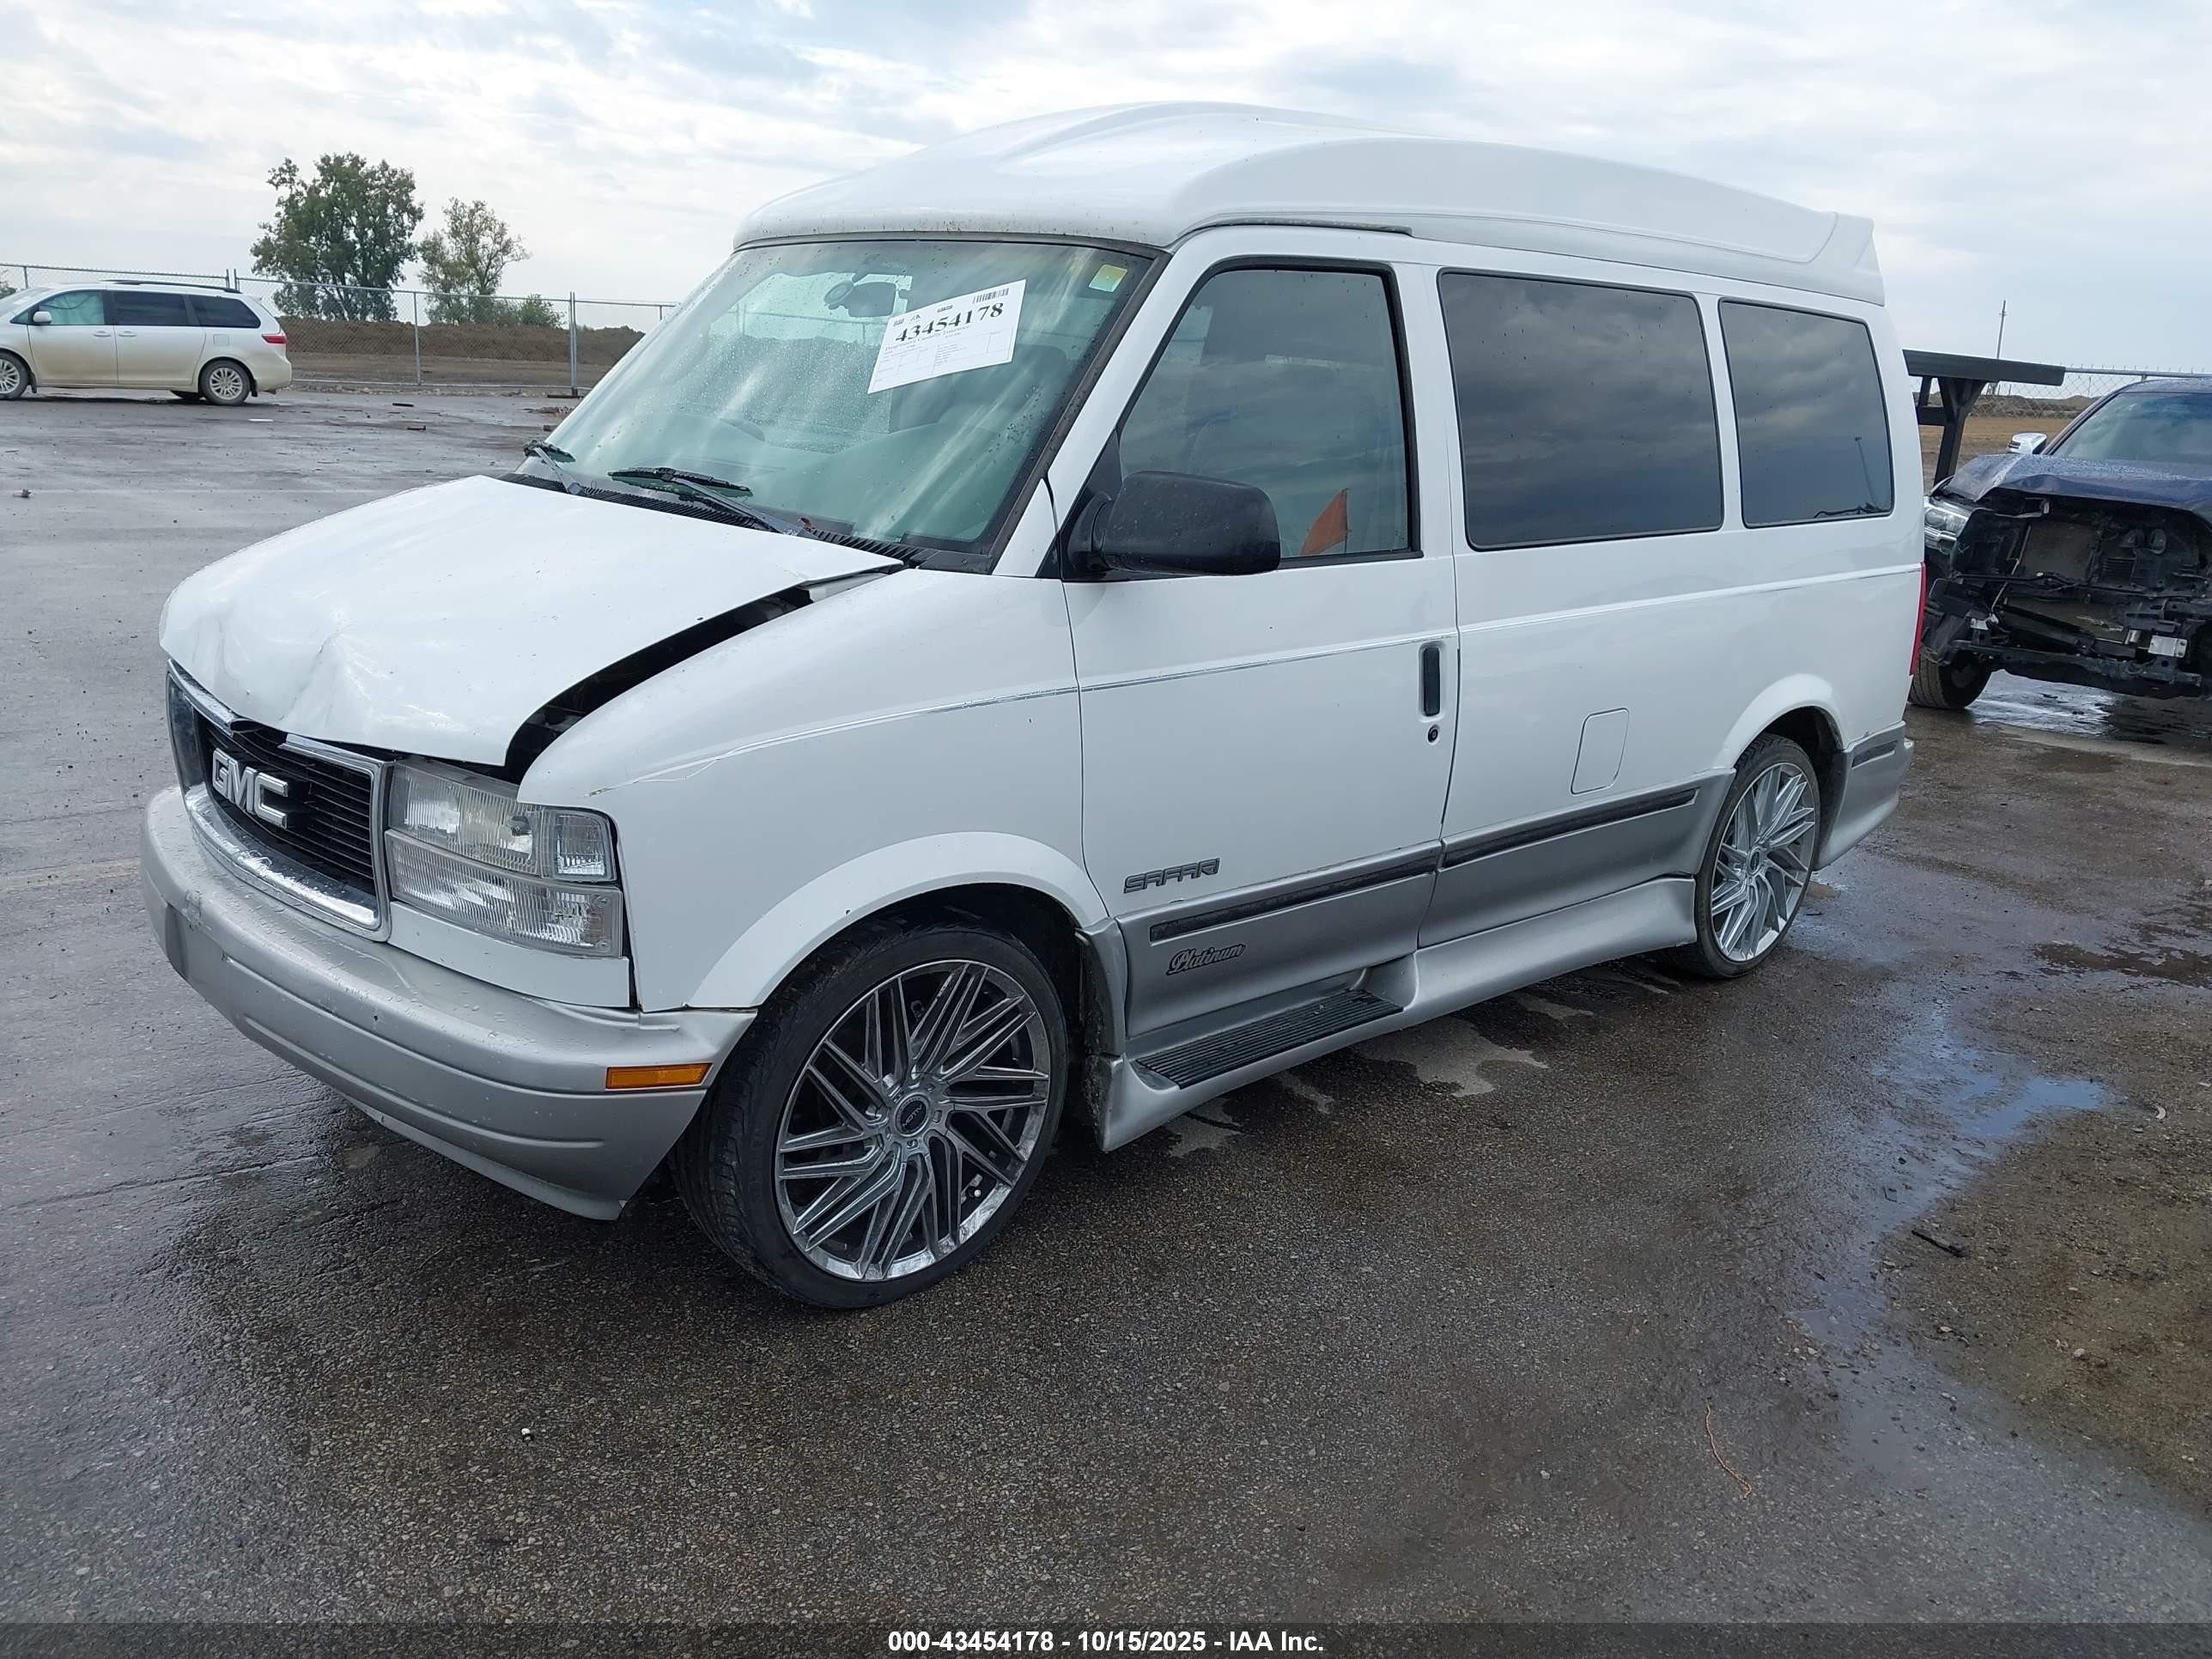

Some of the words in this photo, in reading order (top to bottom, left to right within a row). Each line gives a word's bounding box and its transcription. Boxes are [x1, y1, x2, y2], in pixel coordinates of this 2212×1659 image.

[895, 302, 1004, 342] 43454178
[212, 747, 289, 830] GMC
[1123, 858, 1220, 894] SAFARI
[1165, 944, 1246, 975] Platinum
